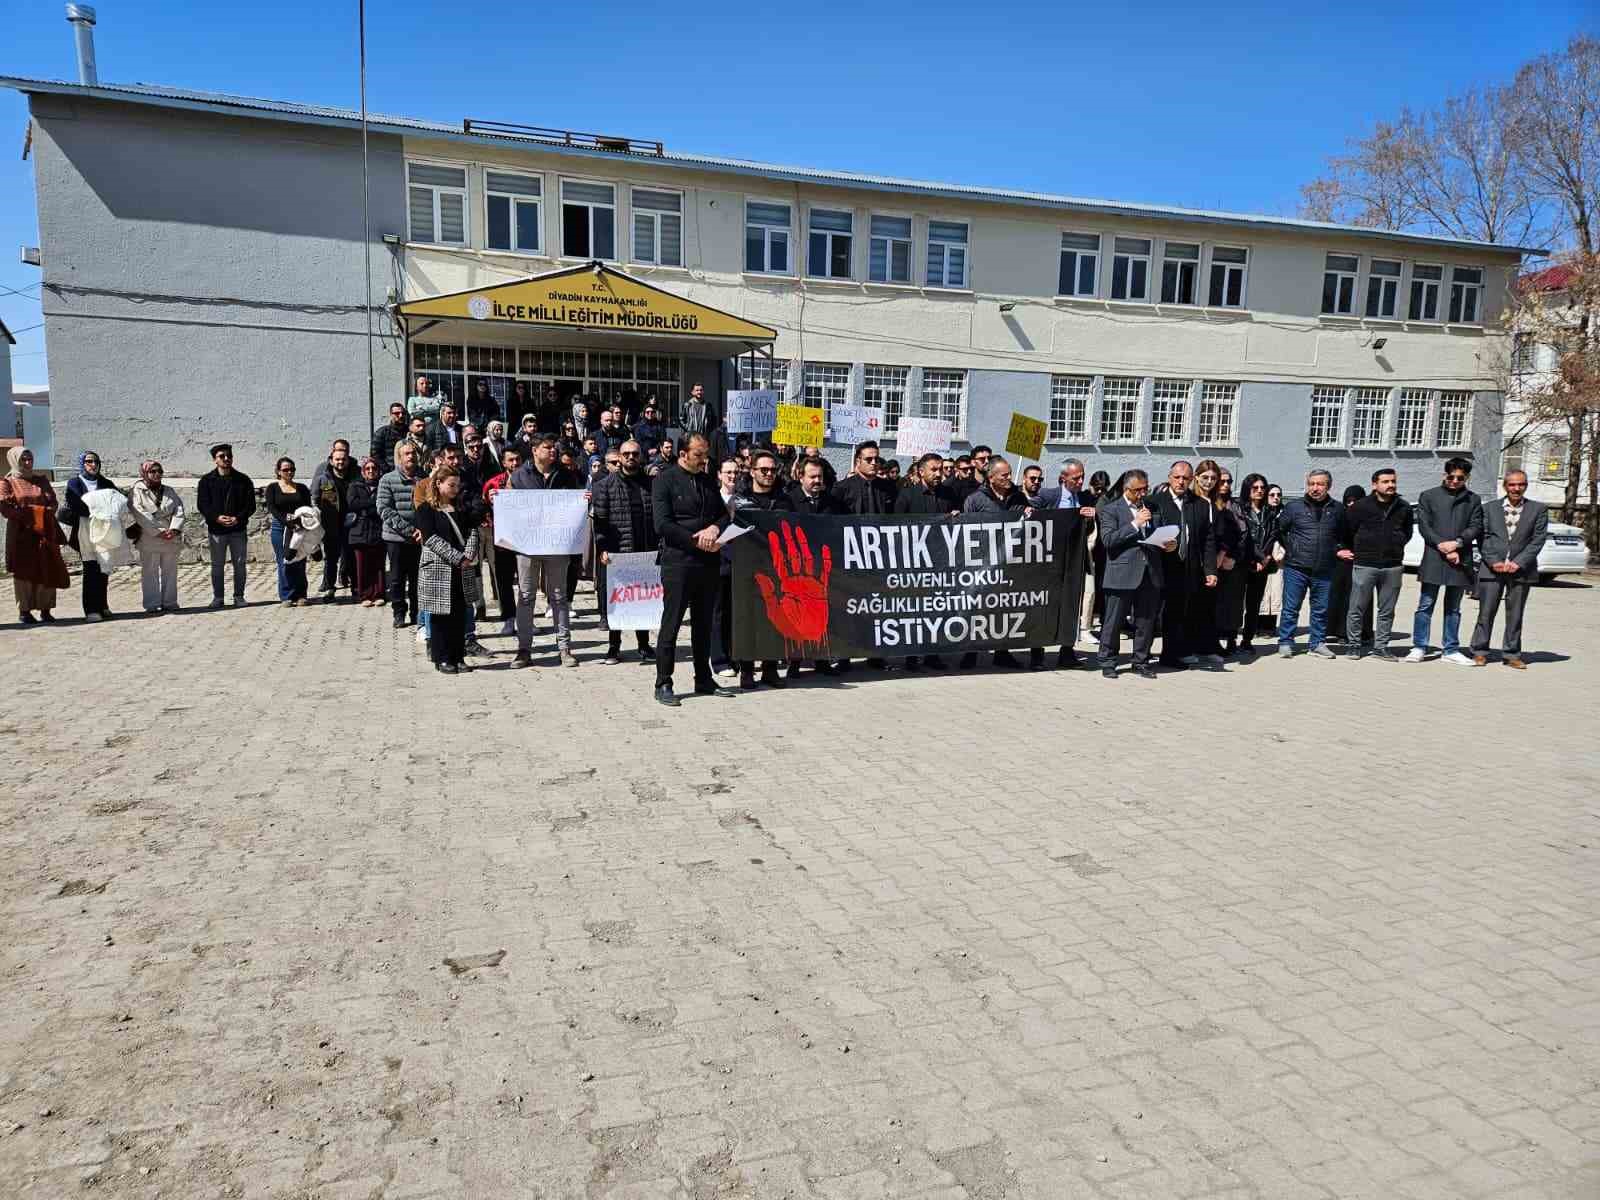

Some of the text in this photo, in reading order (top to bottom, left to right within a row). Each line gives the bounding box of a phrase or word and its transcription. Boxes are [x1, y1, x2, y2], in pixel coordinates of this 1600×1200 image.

[548, 292, 648, 307] DİYADİN KAYMAKAMLIĞI
[493, 300, 698, 330] İLÇE MİLLİ EĞİTİM MÜDÜRLÜĞÜ
[843, 519, 1054, 570] ARTIK YETER!
[958, 569, 1014, 587] OKUL,
[846, 590, 1049, 614] SAĞLIKLI EĞİTİM ORTAMI
[874, 612, 1027, 646] İSTİYORUZ
